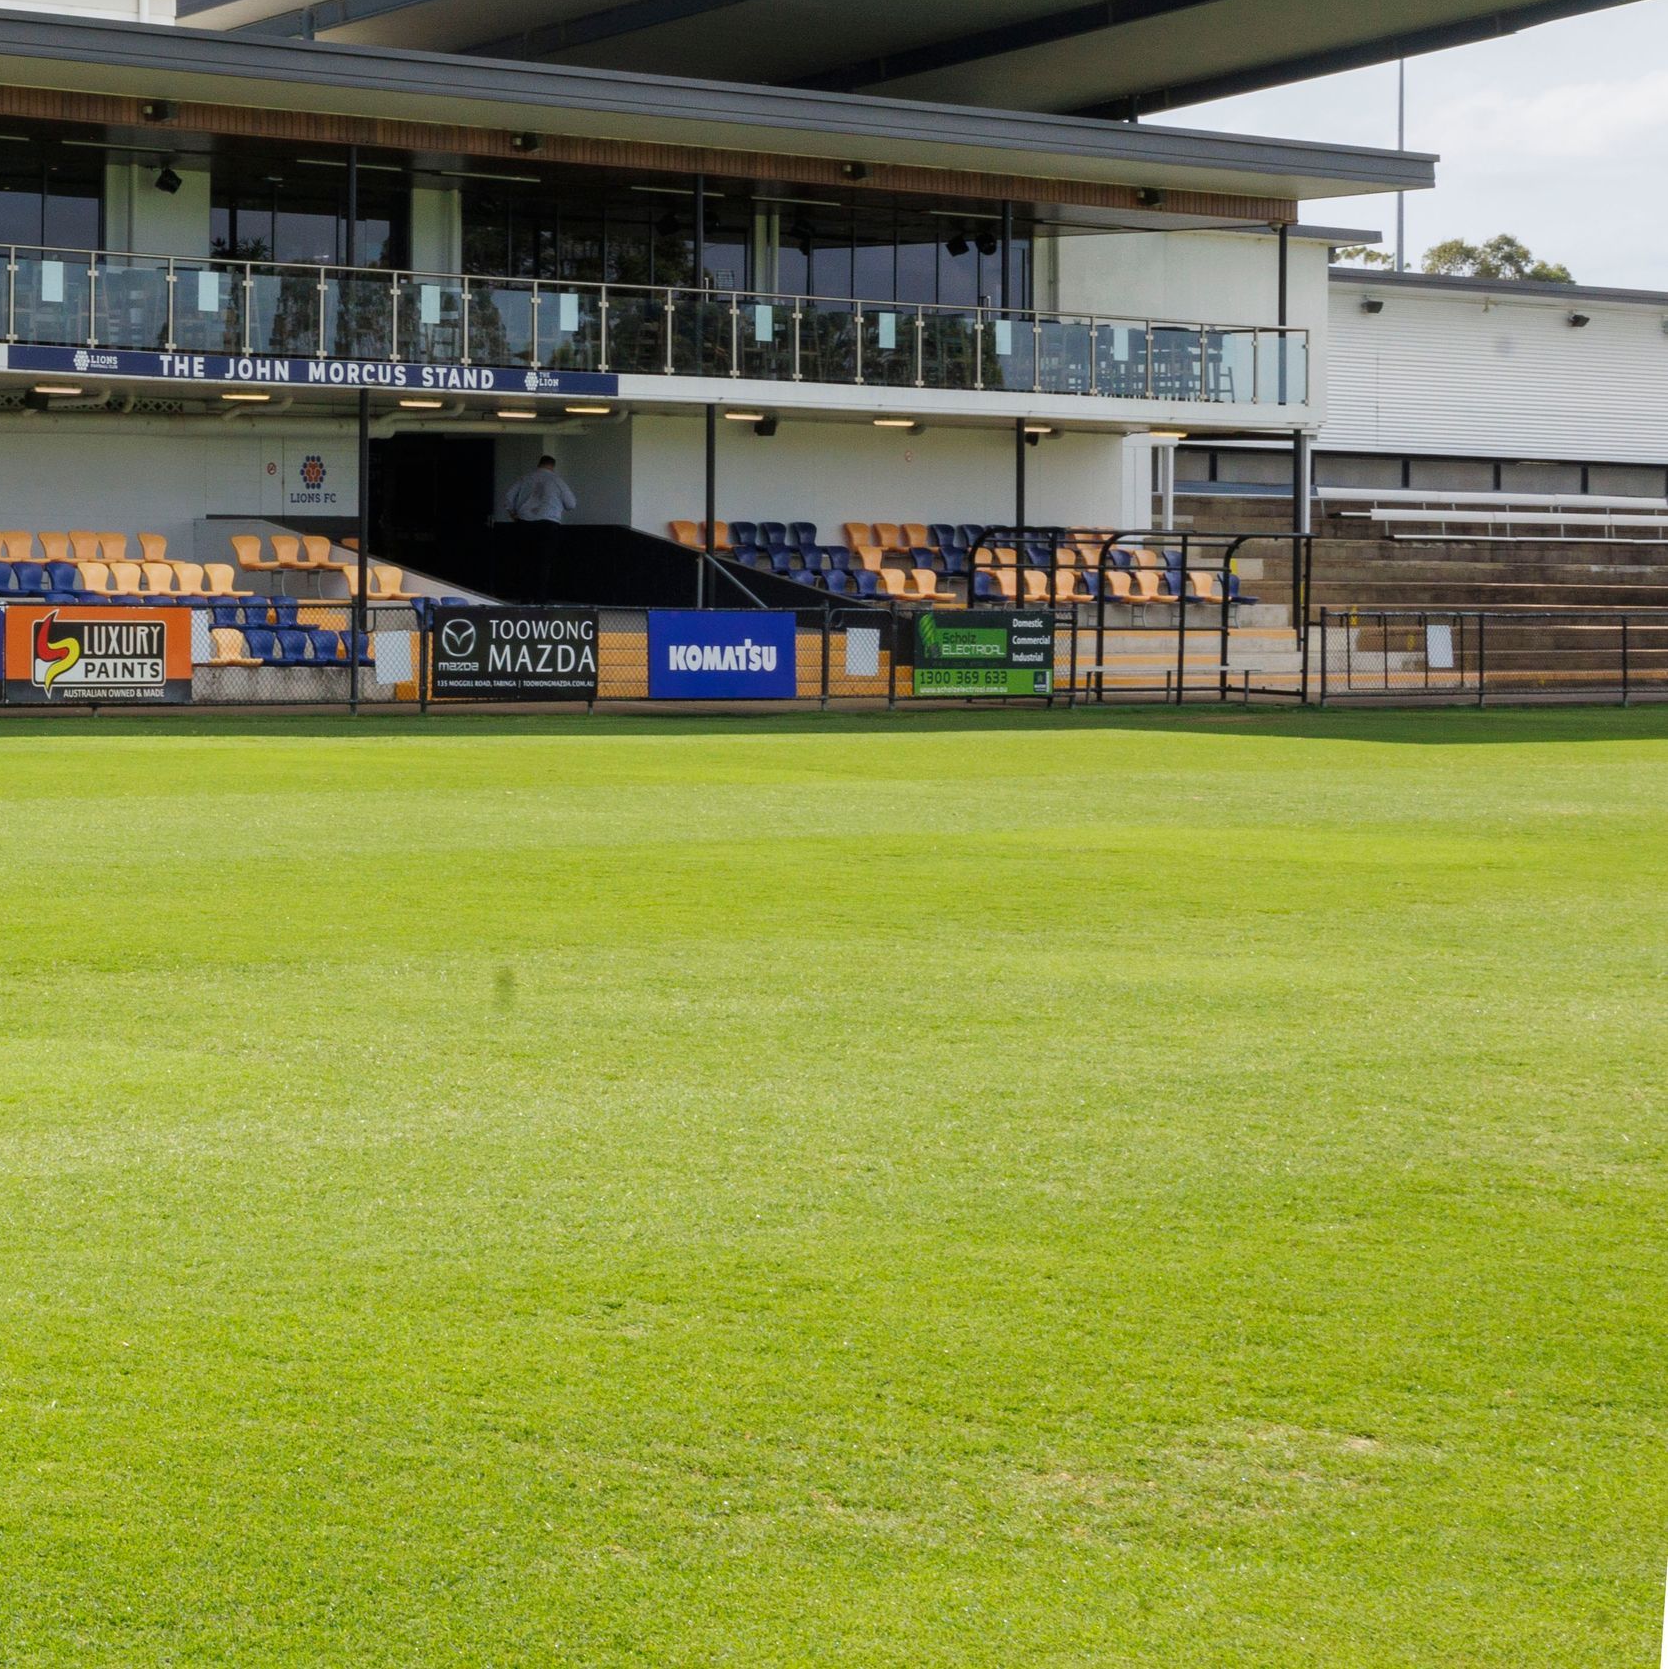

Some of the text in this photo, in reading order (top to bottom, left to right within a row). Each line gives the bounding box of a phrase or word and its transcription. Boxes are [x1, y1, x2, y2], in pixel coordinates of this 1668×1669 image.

[91, 355, 118, 364] LIONS
[159, 354, 495, 390] THE JOHN MORCUS STAND
[538, 378, 559, 387] LION
[290, 492, 337, 503] LIONS FC
[1013, 618, 1043, 628] Domestic
[489, 620, 594, 640] TOOWONG
[83, 625, 160, 655] LUXURY
[943, 632, 976, 644] Scholz
[1013, 635, 1051, 645] Commercial
[488, 644, 596, 672] MAZDA
[669, 638, 777, 672] KOMATSU
[1013, 652, 1043, 662] Industrial
[85, 662, 160, 678] PAINTS
[438, 662, 479, 672] mazda
[920, 670, 1008, 684] 1300 369 633
[64, 689, 165, 698] AUSTRALIAN OWNED & MADE
